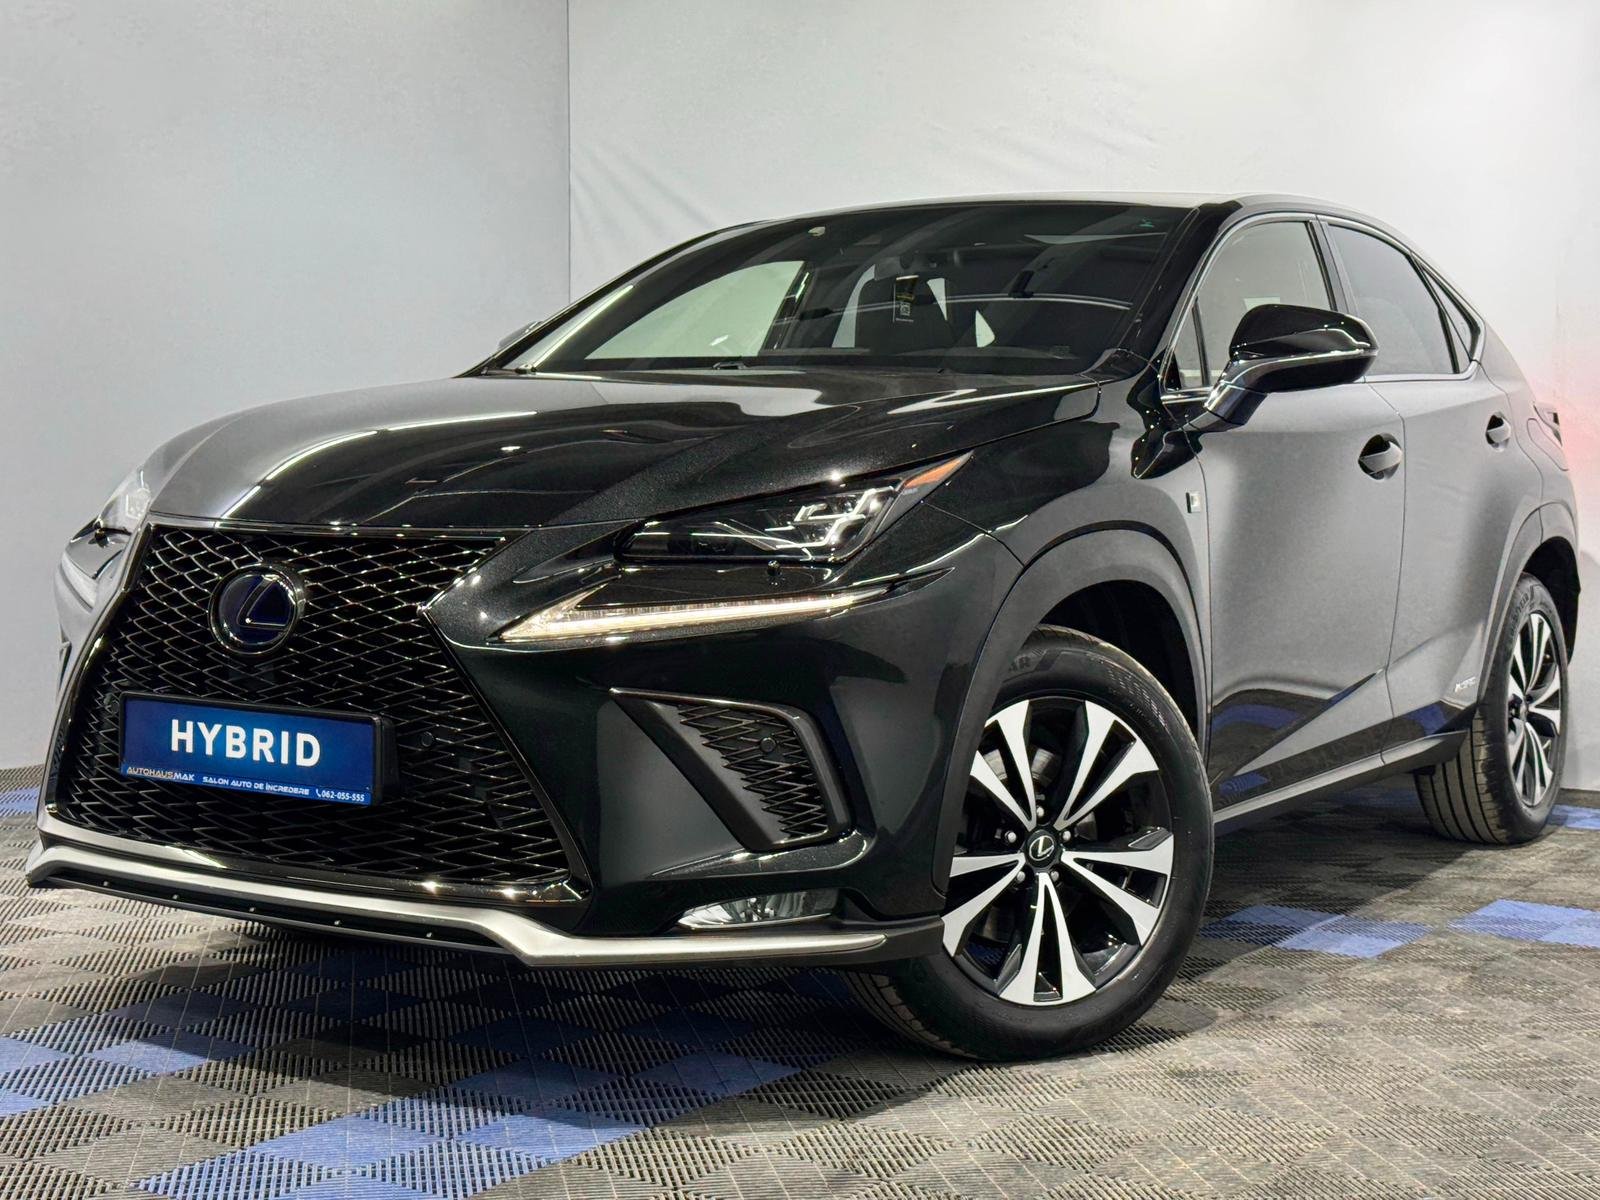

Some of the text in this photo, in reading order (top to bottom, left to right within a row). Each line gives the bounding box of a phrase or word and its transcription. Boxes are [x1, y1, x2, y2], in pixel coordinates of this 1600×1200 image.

[171, 719, 321, 768] HYBRID
[202, 776, 229, 786] SALON
[230, 780, 252, 788] AUTO
[321, 790, 365, 802] 062-055-555
